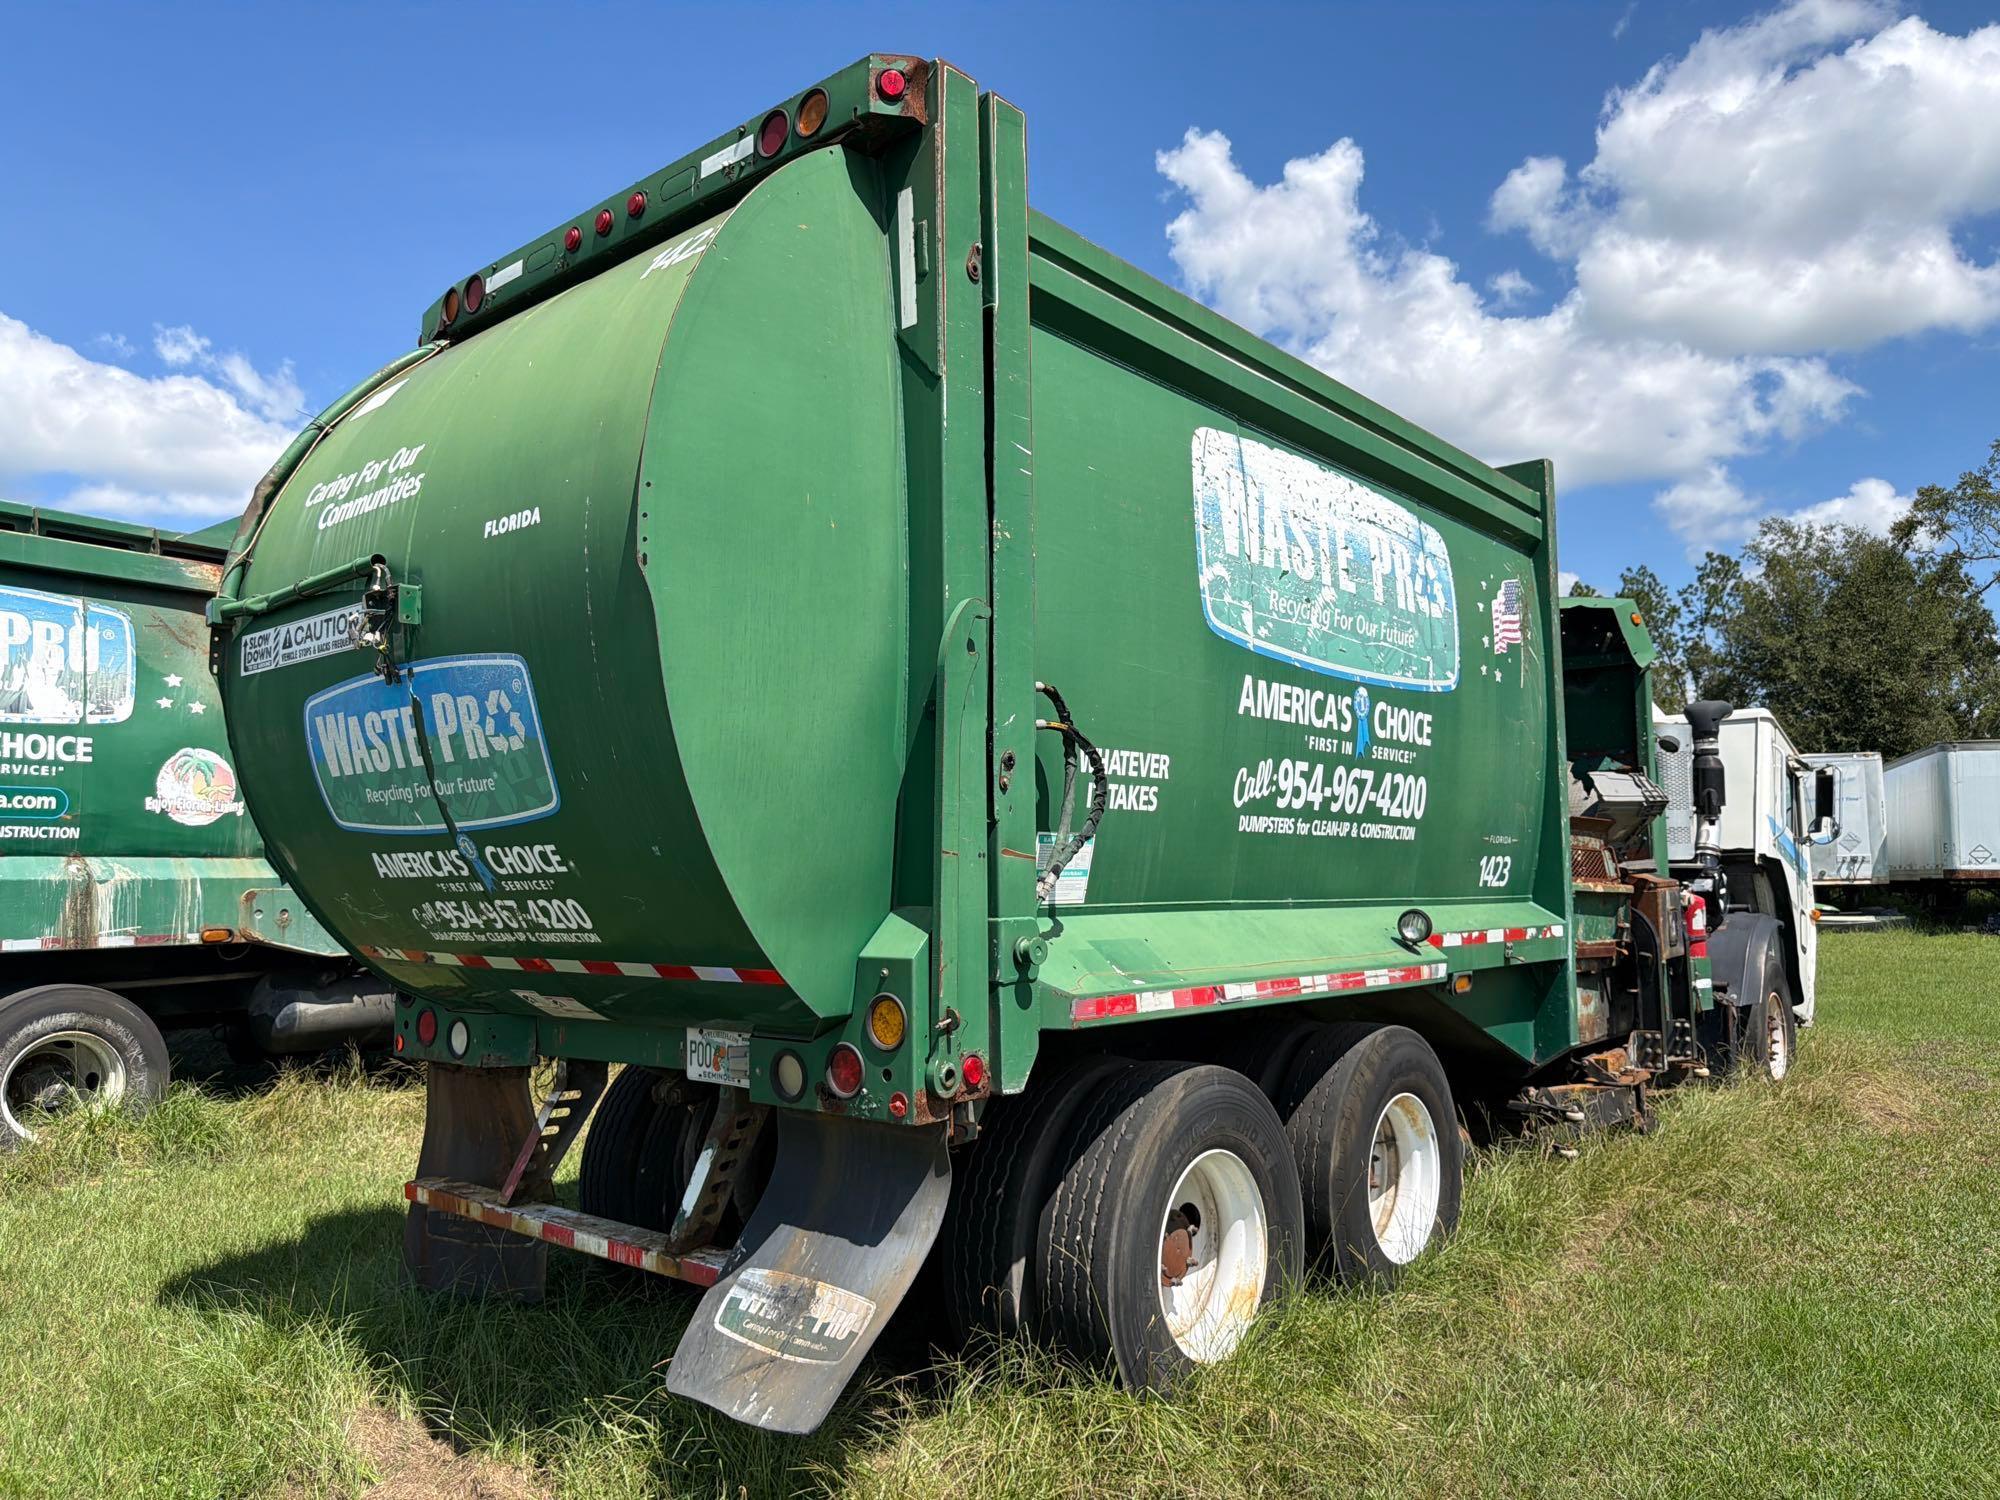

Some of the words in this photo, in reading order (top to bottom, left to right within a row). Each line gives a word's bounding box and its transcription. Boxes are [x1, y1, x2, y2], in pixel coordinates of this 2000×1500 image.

[305, 472, 358, 507] Caring
[359, 457, 388, 487] For
[389, 444, 426, 471] Our
[318, 471, 426, 530] Communities
[484, 506, 541, 538] FLORIDA
[1268, 588, 1332, 630] Recycling
[1333, 608, 1355, 632] For
[1356, 615, 1379, 638] Our
[1379, 620, 1416, 648] Future
[247, 645, 272, 664] DOWN
[248, 631, 271, 650] SLOW
[299, 646, 312, 659] STOPS
[1238, 674, 1353, 732] AMERICA'S
[1373, 701, 1432, 746] CHOICE
[0, 731, 93, 762] HOICE
[314, 705, 425, 778] WASTE
[431, 688, 527, 763] PRO
[1341, 740, 1353, 755] IN
[365, 783, 413, 805] Recycling
[414, 781, 433, 798] For
[434, 779, 456, 797] Our
[456, 775, 496, 794] Future
[1108, 783, 1159, 812] TAKES
[1233, 757, 1277, 809] Call:
[1276, 758, 1427, 820] 954-967-4200
[145, 796, 174, 813] Enjoy
[1238, 815, 1295, 835] DUMPSTERS
[1296, 820, 1311, 835] for
[1311, 822, 1350, 839] CLEAN-UP
[1351, 824, 1358, 838] &
[1359, 823, 1416, 841] CONSTRUCTION
[371, 848, 470, 879] AMERICA'S
[484, 844, 569, 876] CHOICE
[1478, 855, 1512, 887] 1423
[469, 881, 486, 892] IN
[474, 931, 487, 943] for
[485, 932, 527, 943] CLEAN-UP
[535, 932, 602, 944] CONSTRUCTION
